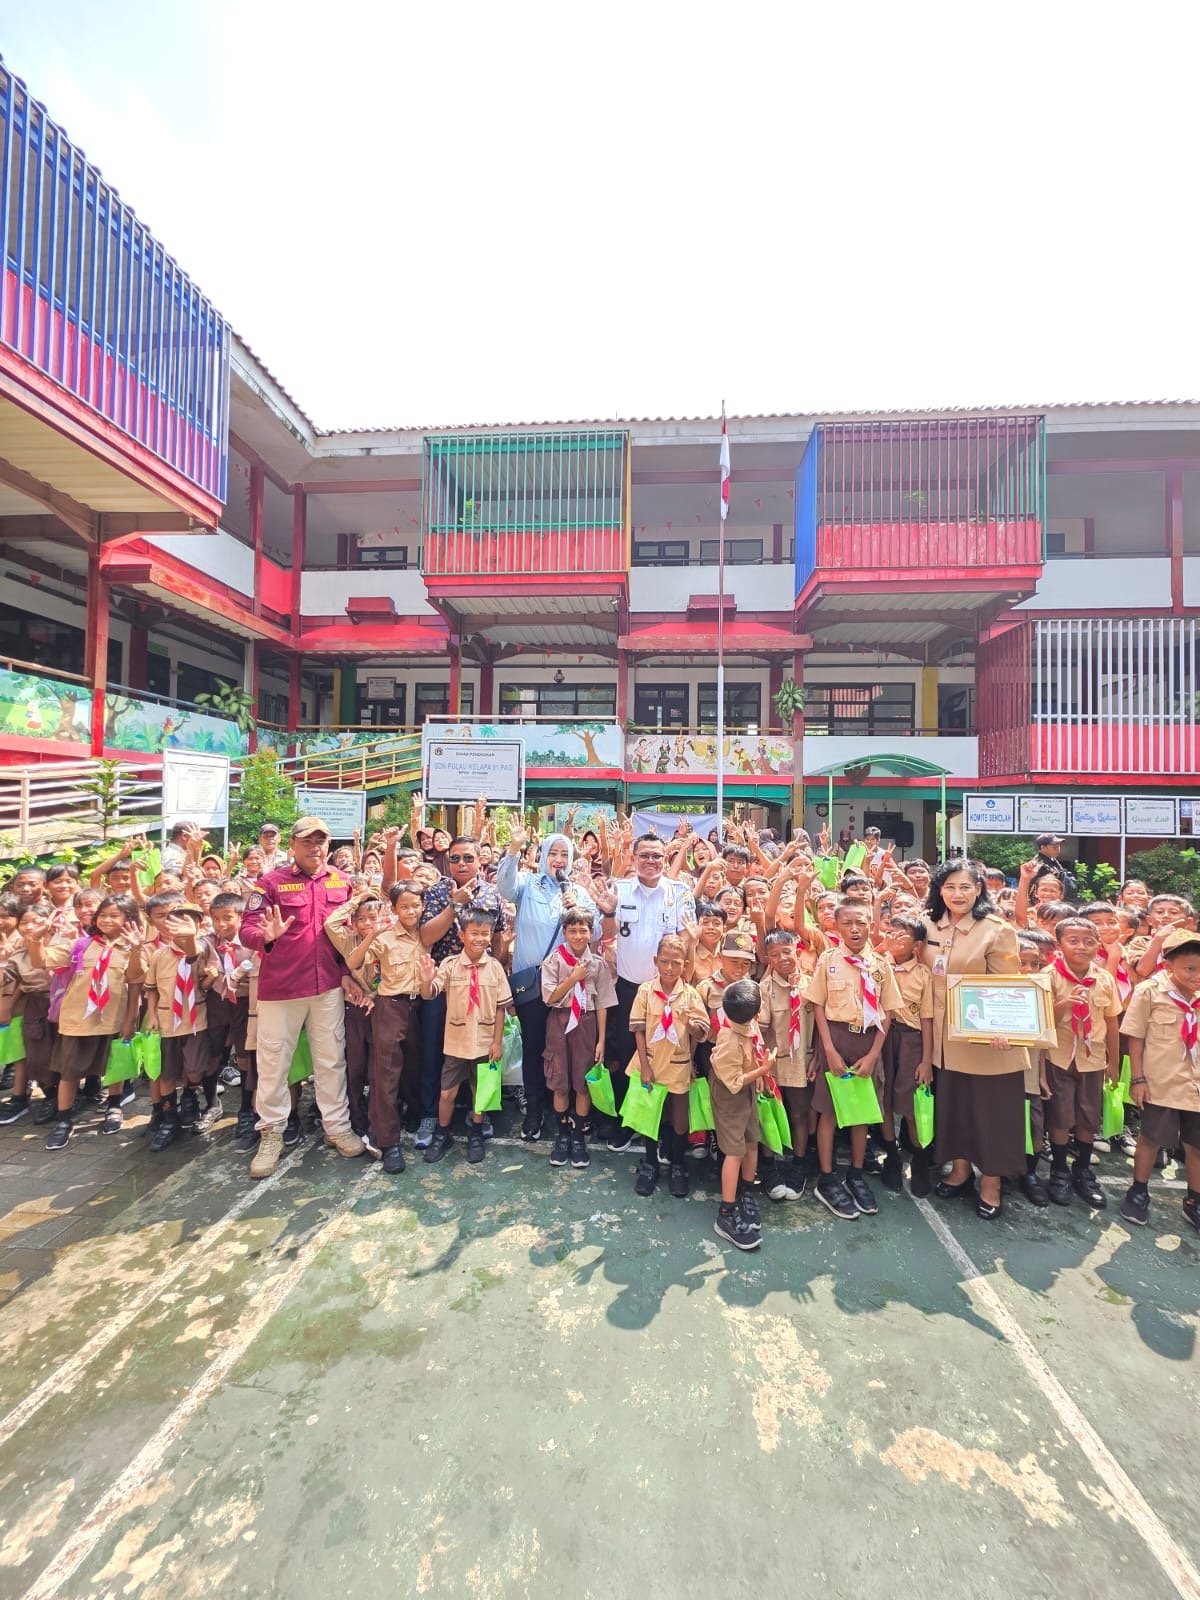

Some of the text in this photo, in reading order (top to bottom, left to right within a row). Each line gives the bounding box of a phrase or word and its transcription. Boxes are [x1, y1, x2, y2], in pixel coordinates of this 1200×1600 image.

[447, 762, 467, 770] PULAU
[970, 813, 1012, 823] KOMITE SEKOLAH
